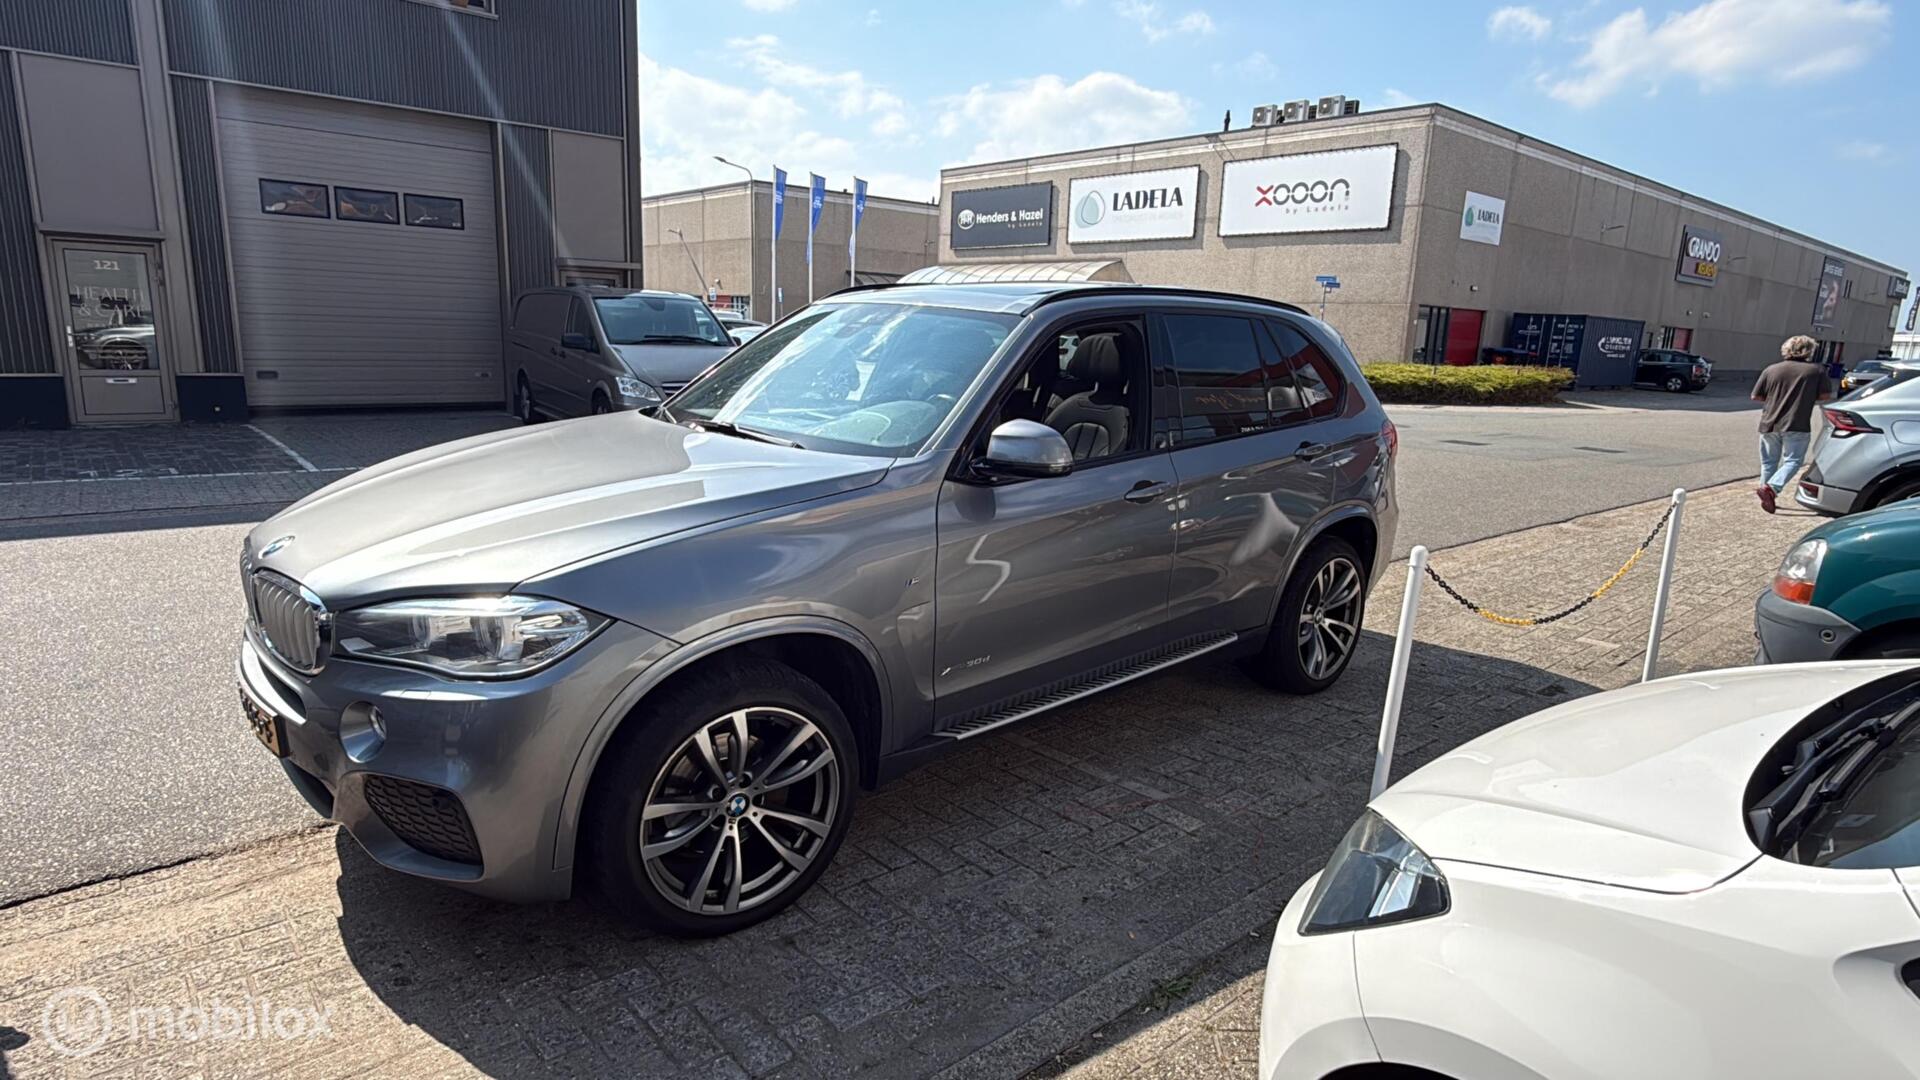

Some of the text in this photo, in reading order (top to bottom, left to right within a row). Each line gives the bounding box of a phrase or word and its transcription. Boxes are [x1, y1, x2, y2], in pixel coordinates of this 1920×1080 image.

[1112, 187, 1183, 211] LADELA
[976, 207, 1044, 224] Henders & Hazel
[1477, 209, 1500, 225] LADELA
[1689, 236, 1721, 263] GRANDO
[93, 260, 120, 271] 121
[75, 285, 145, 303] HEALTH
[79, 303, 92, 317] &
